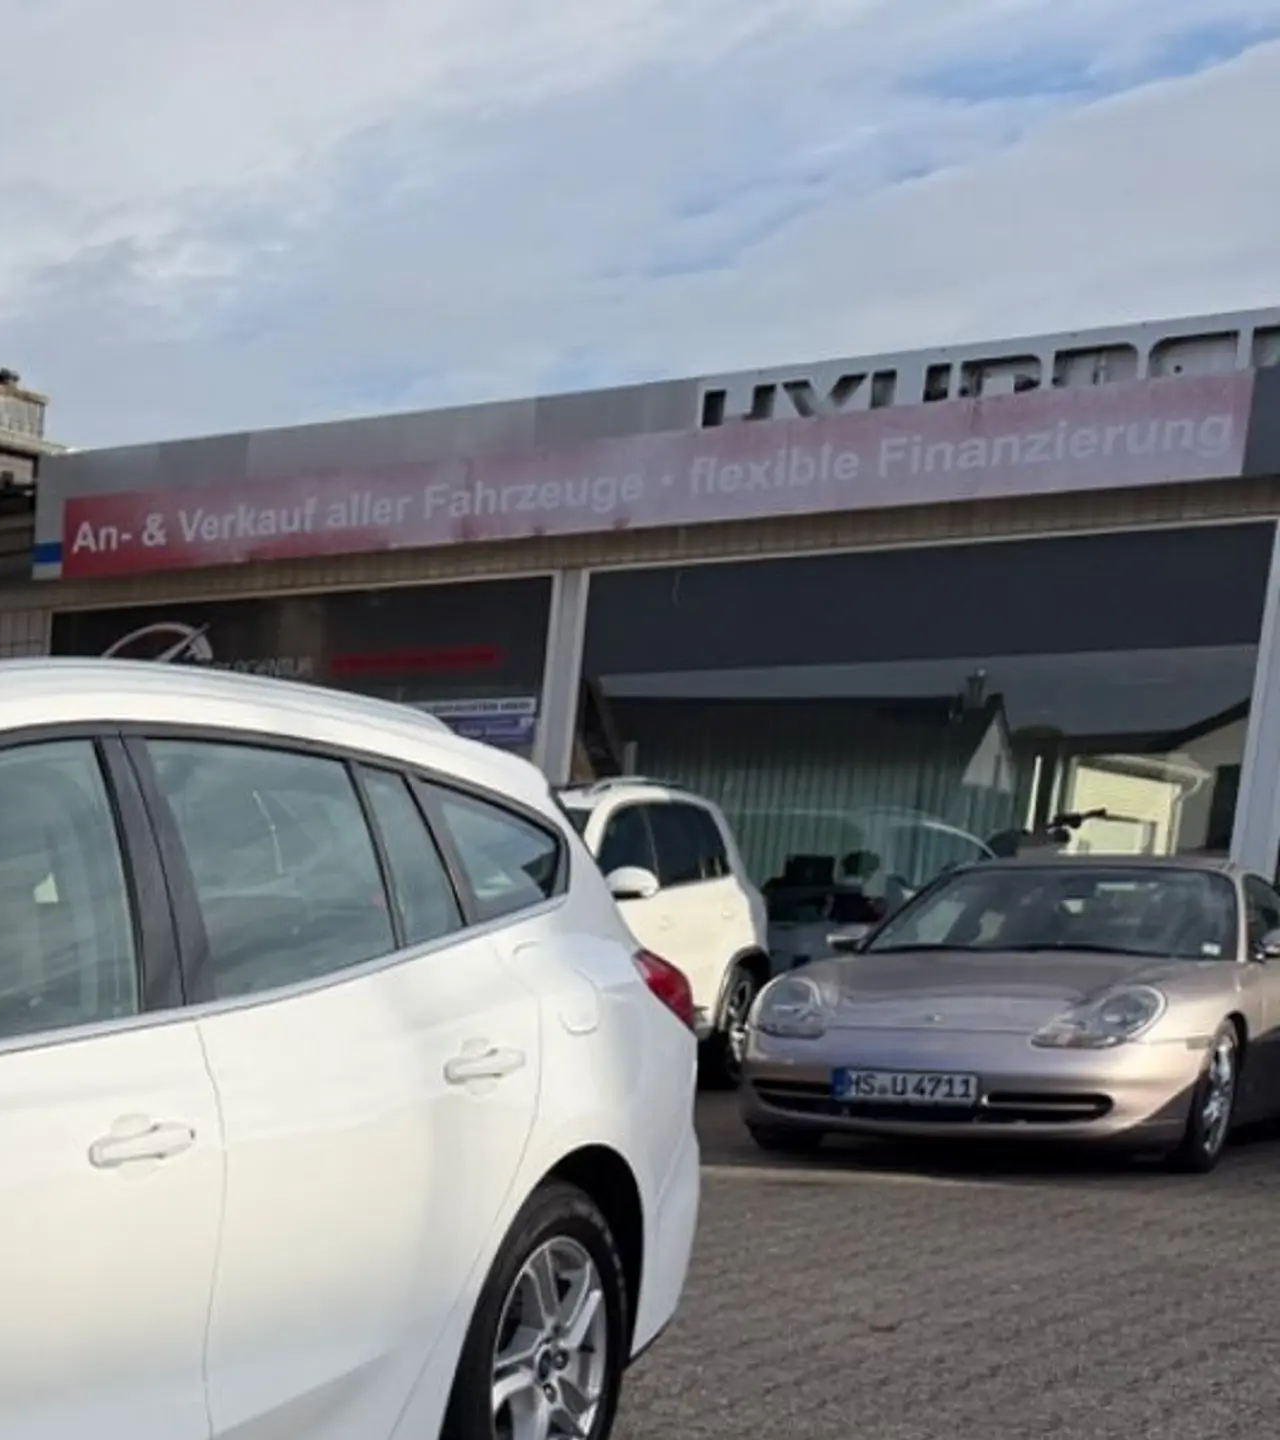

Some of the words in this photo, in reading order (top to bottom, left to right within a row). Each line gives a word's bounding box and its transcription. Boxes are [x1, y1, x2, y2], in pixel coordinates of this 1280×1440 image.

[71, 518, 132, 555] An-
[141, 512, 168, 548] &
[179, 501, 318, 545] Verkauf
[325, 492, 410, 531] aller
[423, 468, 643, 523] Fahrzeuge
[689, 443, 860, 497] flexible
[878, 410, 1235, 479] Finanzierung
